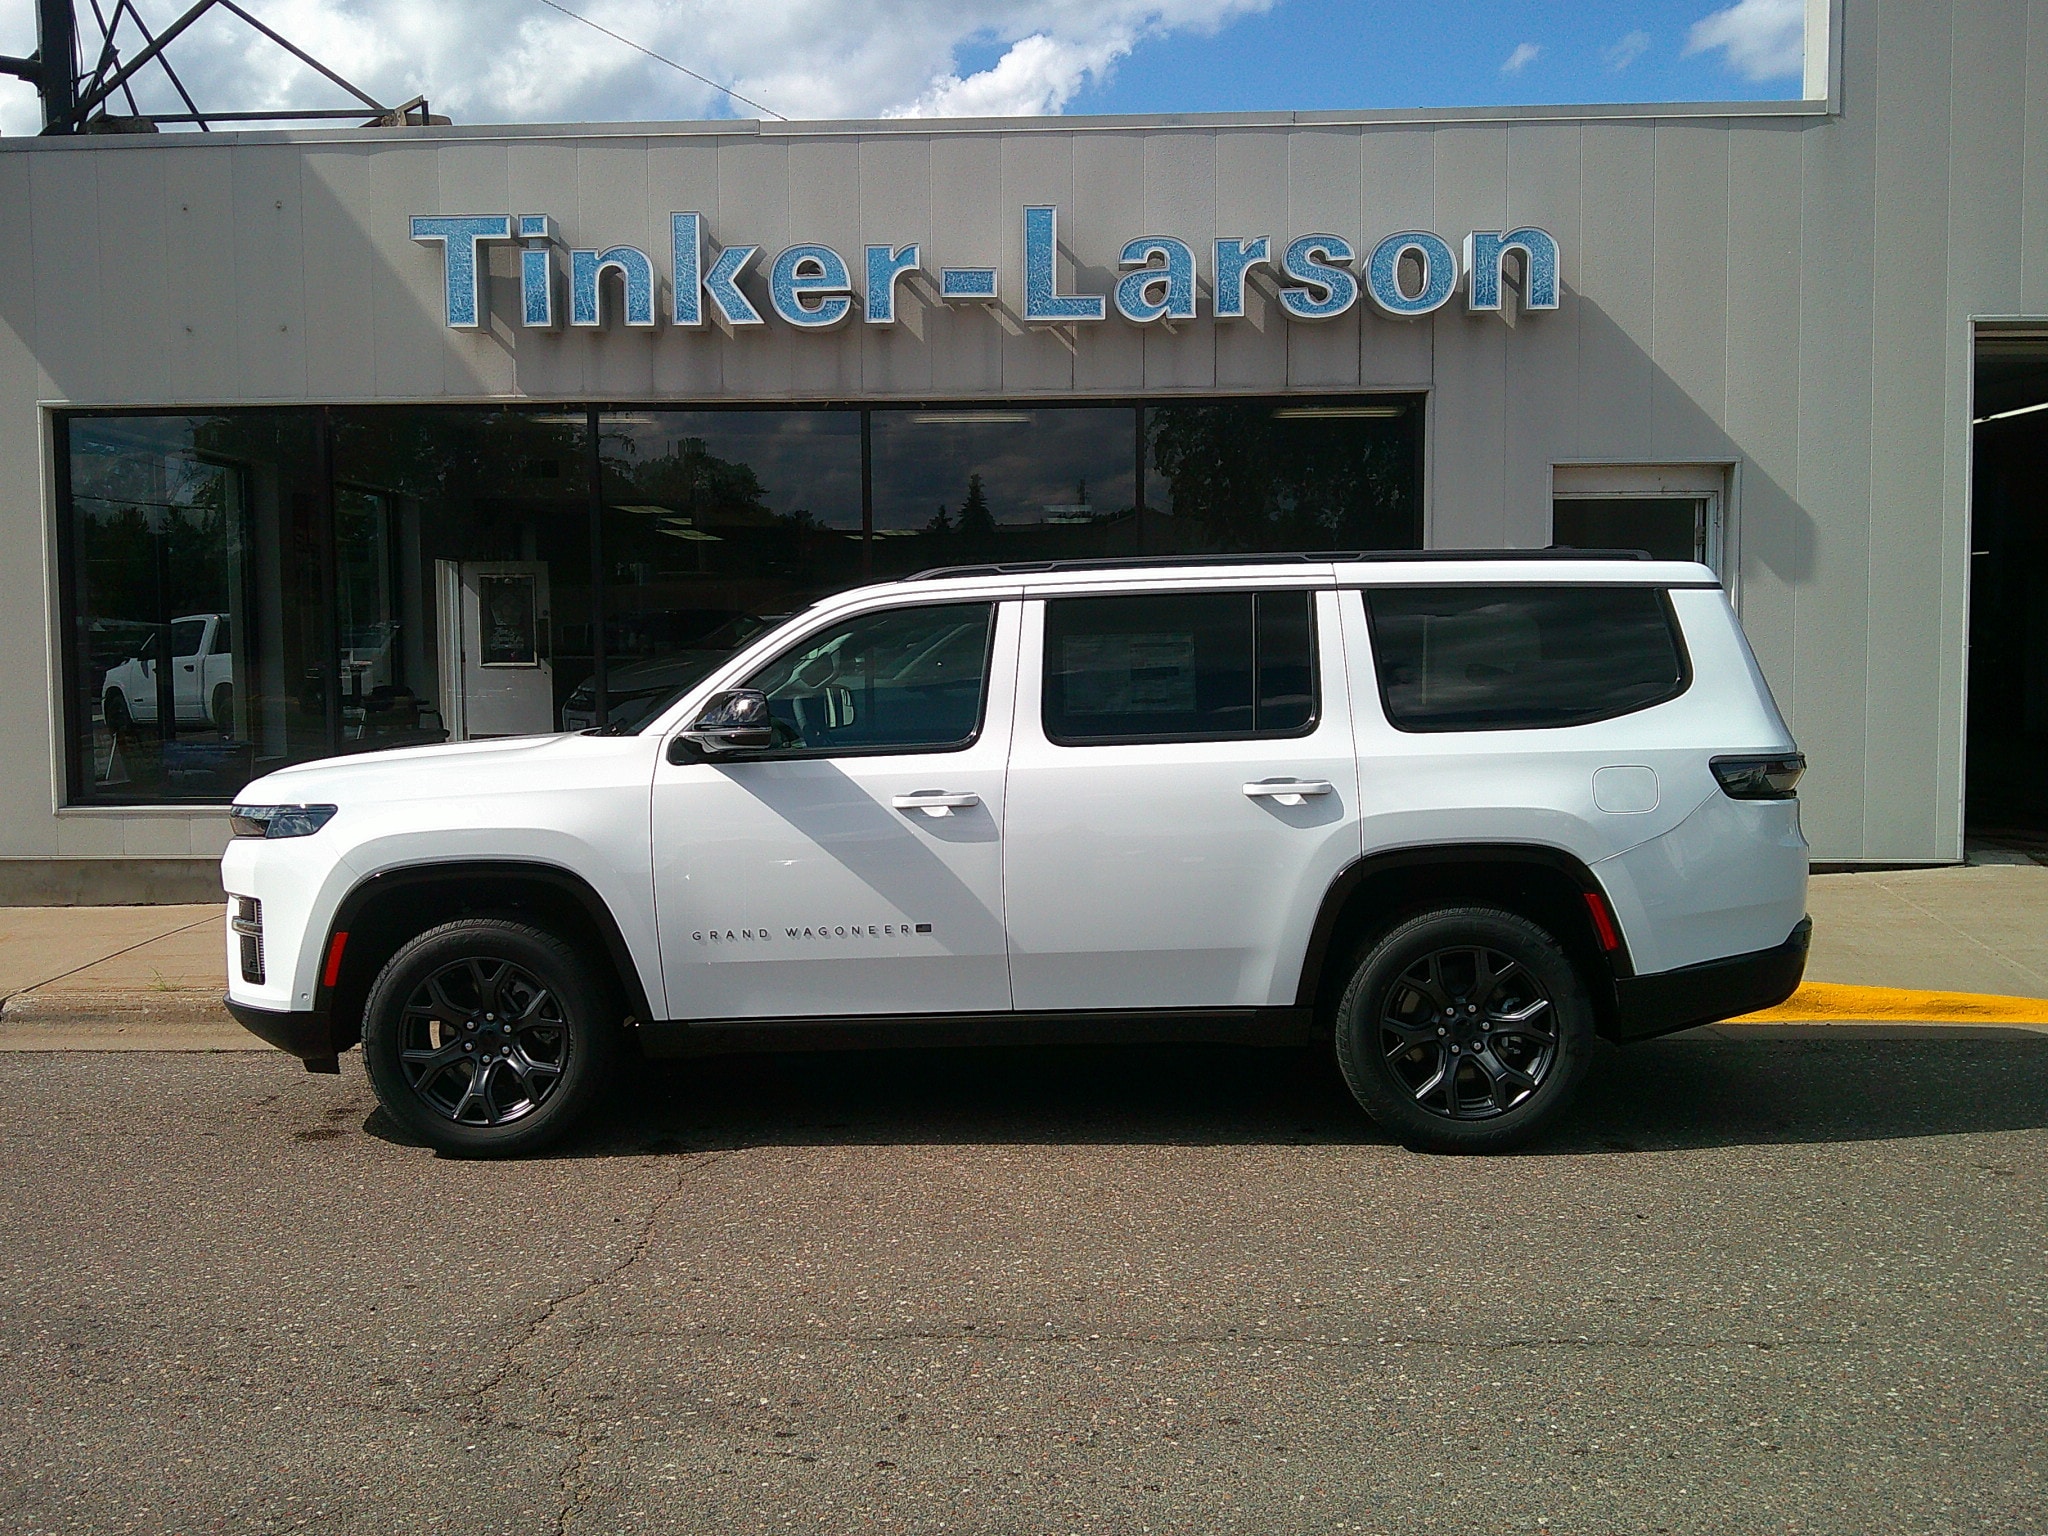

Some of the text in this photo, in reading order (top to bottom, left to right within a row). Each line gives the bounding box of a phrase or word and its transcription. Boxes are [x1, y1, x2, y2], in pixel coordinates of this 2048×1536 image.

[408, 203, 1562, 328] Tinker-Larson
[691, 924, 910, 941] GRAND WAGONEER
